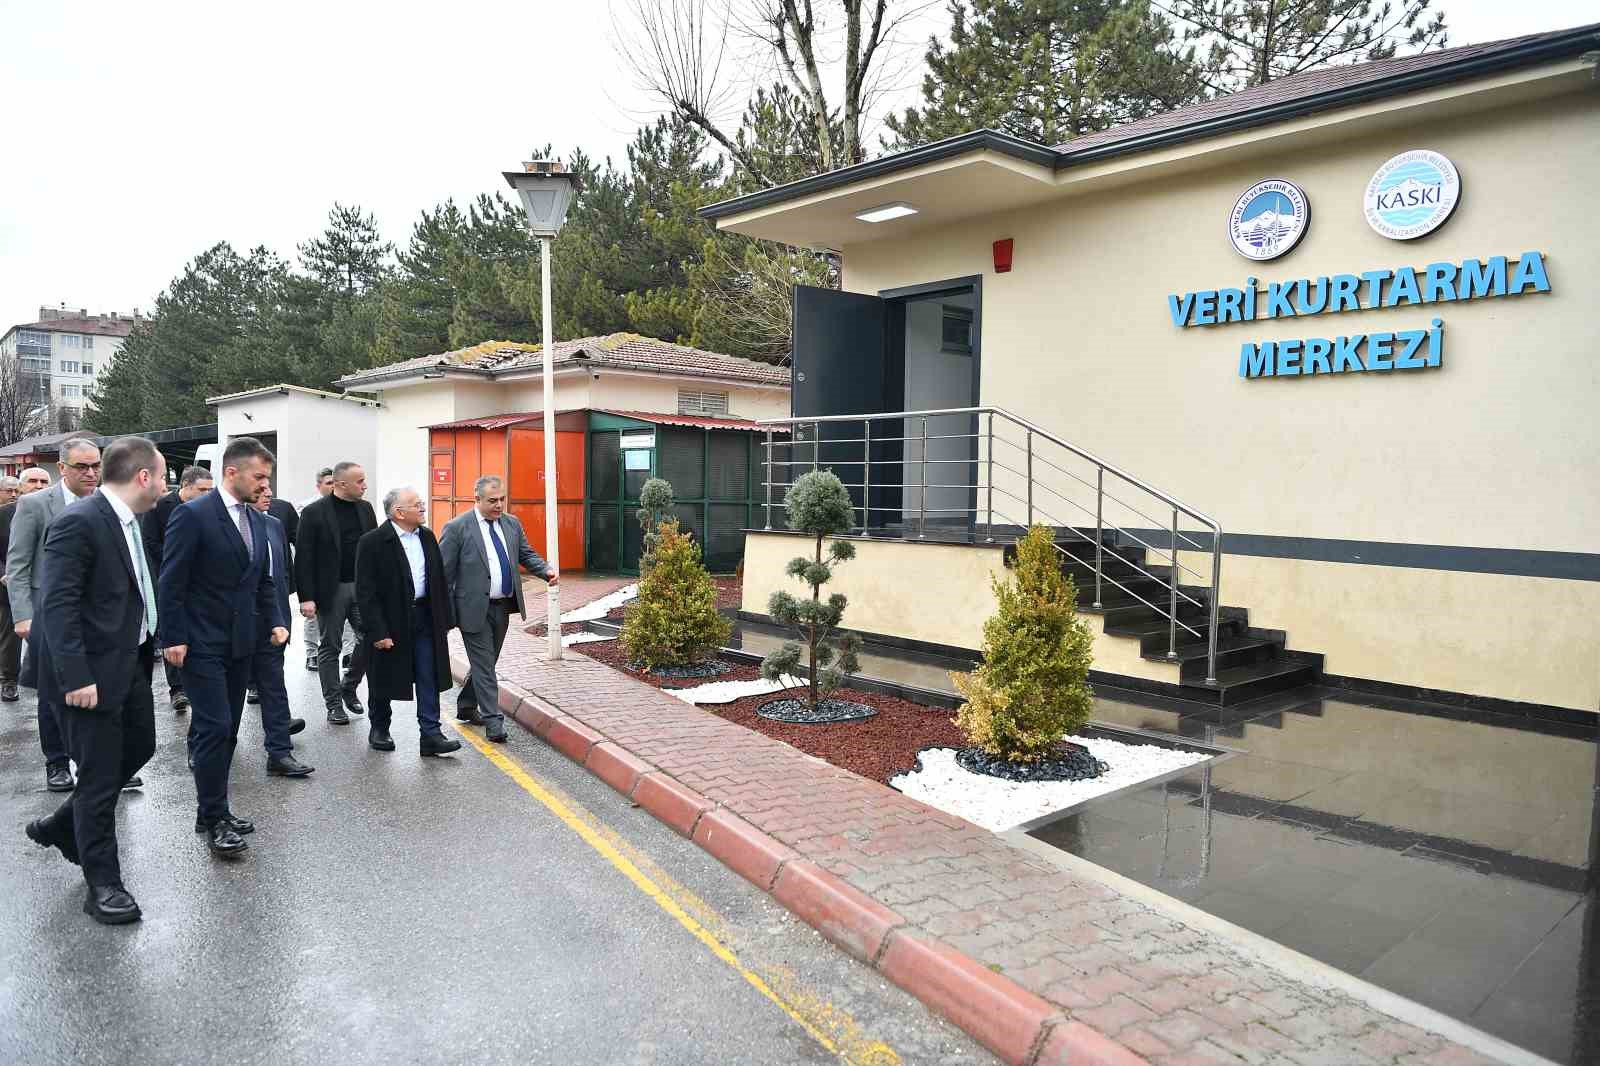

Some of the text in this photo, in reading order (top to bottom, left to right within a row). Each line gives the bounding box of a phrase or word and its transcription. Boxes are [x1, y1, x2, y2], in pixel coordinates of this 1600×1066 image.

[1168, 251, 1551, 327] VERİ KURTARMA
[1239, 318, 1445, 378] MERKEZİ
